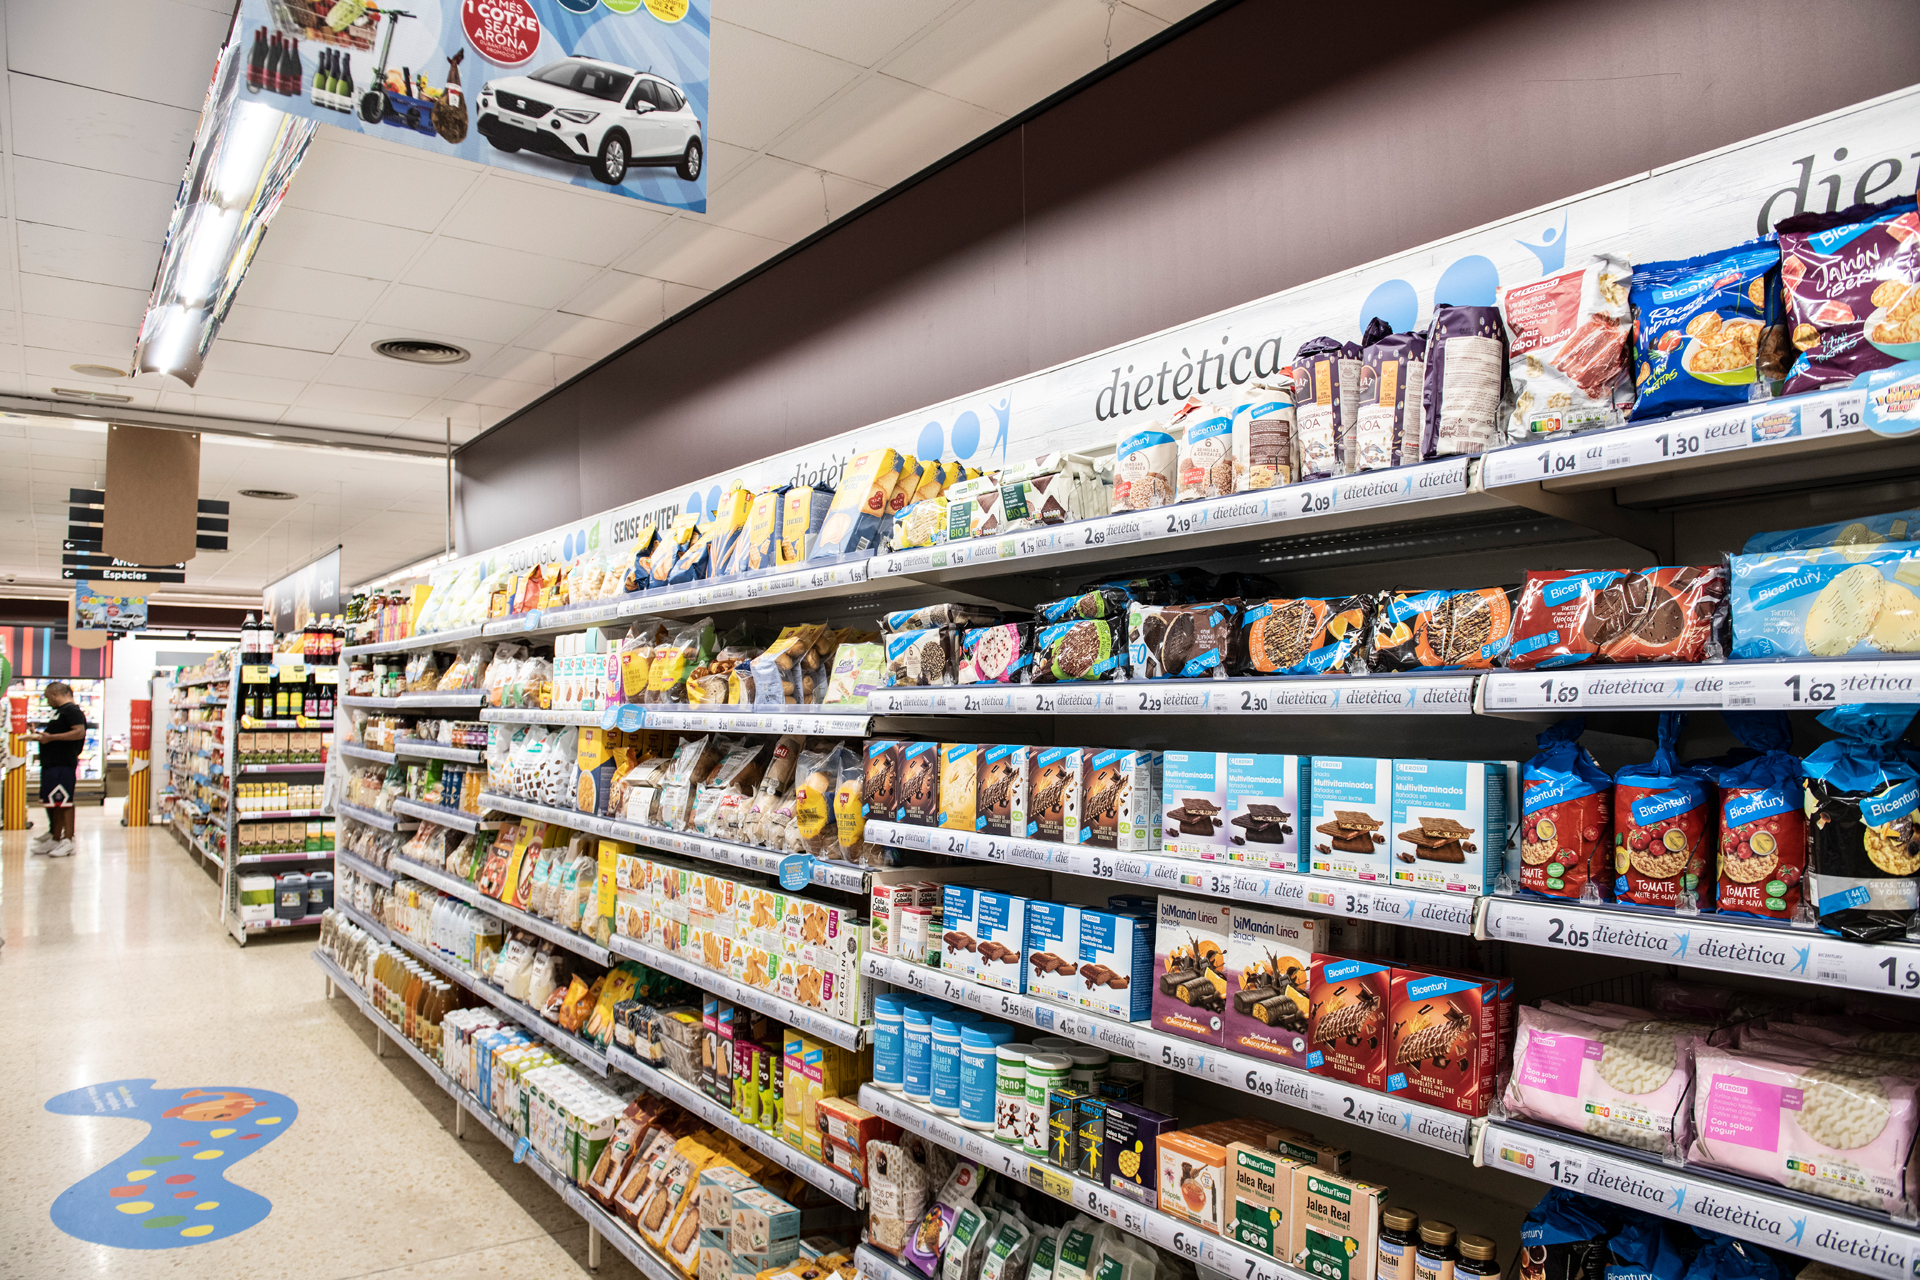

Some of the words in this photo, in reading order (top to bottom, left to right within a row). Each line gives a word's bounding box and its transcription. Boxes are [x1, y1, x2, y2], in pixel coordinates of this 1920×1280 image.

[467, 1, 474, 14] 1
[478, 4, 537, 32] COTXE
[485, 19, 520, 38] SEAT
[475, 28, 528, 52] ARONA
[1539, 328, 1571, 345] jamón
[1095, 335, 1283, 421] dietètica
[1190, 420, 1228, 440] Bicentury
[1119, 435, 1150, 455] Bicentury
[1343, 481, 1398, 500] dietètica
[1213, 503, 1259, 520] dietètica
[614, 516, 640, 544] SENSE
[103, 571, 147, 581] Espècies
[1758, 567, 1822, 602] Bicentury
[1550, 573, 1607, 600] Bicentury
[1588, 679, 1665, 696] dietètica
[1694, 677, 1724, 693] die
[1057, 692, 1092, 707] dietètica
[1277, 689, 1327, 706] dietètica
[1346, 688, 1391, 704] dietètica
[987, 747, 1007, 761] Bicentury
[1040, 750, 1061, 764] Bicentury
[1094, 752, 1117, 767] Bicentury
[1165, 771, 1214, 781] Multivitaminados
[1405, 765, 1427, 773] EROSKI
[1229, 775, 1282, 786] Multivitaminados
[1314, 779, 1374, 790] Multivitaminados
[1314, 793, 1337, 801] chocolate
[1396, 783, 1464, 796] Multivitaminados
[1396, 792, 1419, 800] Bañados
[1525, 785, 1565, 808] Bicentury
[1395, 798, 1423, 807] chocolate
[1435, 800, 1451, 808] leche
[1639, 793, 1693, 819] Bicentury
[1730, 795, 1785, 819] Bicentury
[1011, 844, 1044, 862] dietètica
[1274, 884, 1304, 899] dietè
[1636, 879, 1676, 895] TOMATE
[1726, 885, 1761, 900] TOMATE
[1886, 887, 1912, 897] QUESO
[1160, 916, 1182, 929] Snack
[1161, 902, 1198, 922] biManán
[1198, 910, 1218, 926] Línea
[1233, 930, 1257, 944] Snack
[1234, 916, 1275, 937] biManán
[1276, 924, 1300, 941] Línea
[1593, 925, 1669, 952] dietètica
[1699, 937, 1786, 967] dietètica
[1328, 964, 1360, 980] Bicentury
[838, 950, 848, 1018] CAROLINA
[1412, 980, 1448, 996] Bicentury
[1241, 1038, 1288, 1056] ChocoNaranja
[1524, 1074, 1547, 1088] yogurt
[1526, 1067, 1538, 1078] Con
[1539, 1072, 1559, 1083] sabor
[1724, 1084, 1748, 1095] EROSKI
[1710, 1124, 1736, 1138] yogurt
[1711, 1117, 1728, 1128] Con
[1729, 1121, 1753, 1134] sabor
[1247, 1156, 1275, 1176] NaturTierra
[1236, 1170, 1256, 1188] Jalea
[1257, 1178, 1275, 1195] Real
[1588, 1168, 1665, 1204] dietètica
[1319, 1183, 1351, 1202] NaturTierra
[1306, 1197, 1329, 1216] Jalea
[1330, 1205, 1351, 1224] Real
[1695, 1196, 1782, 1236] dietètica
[1380, 1250, 1399, 1268] Reishi
